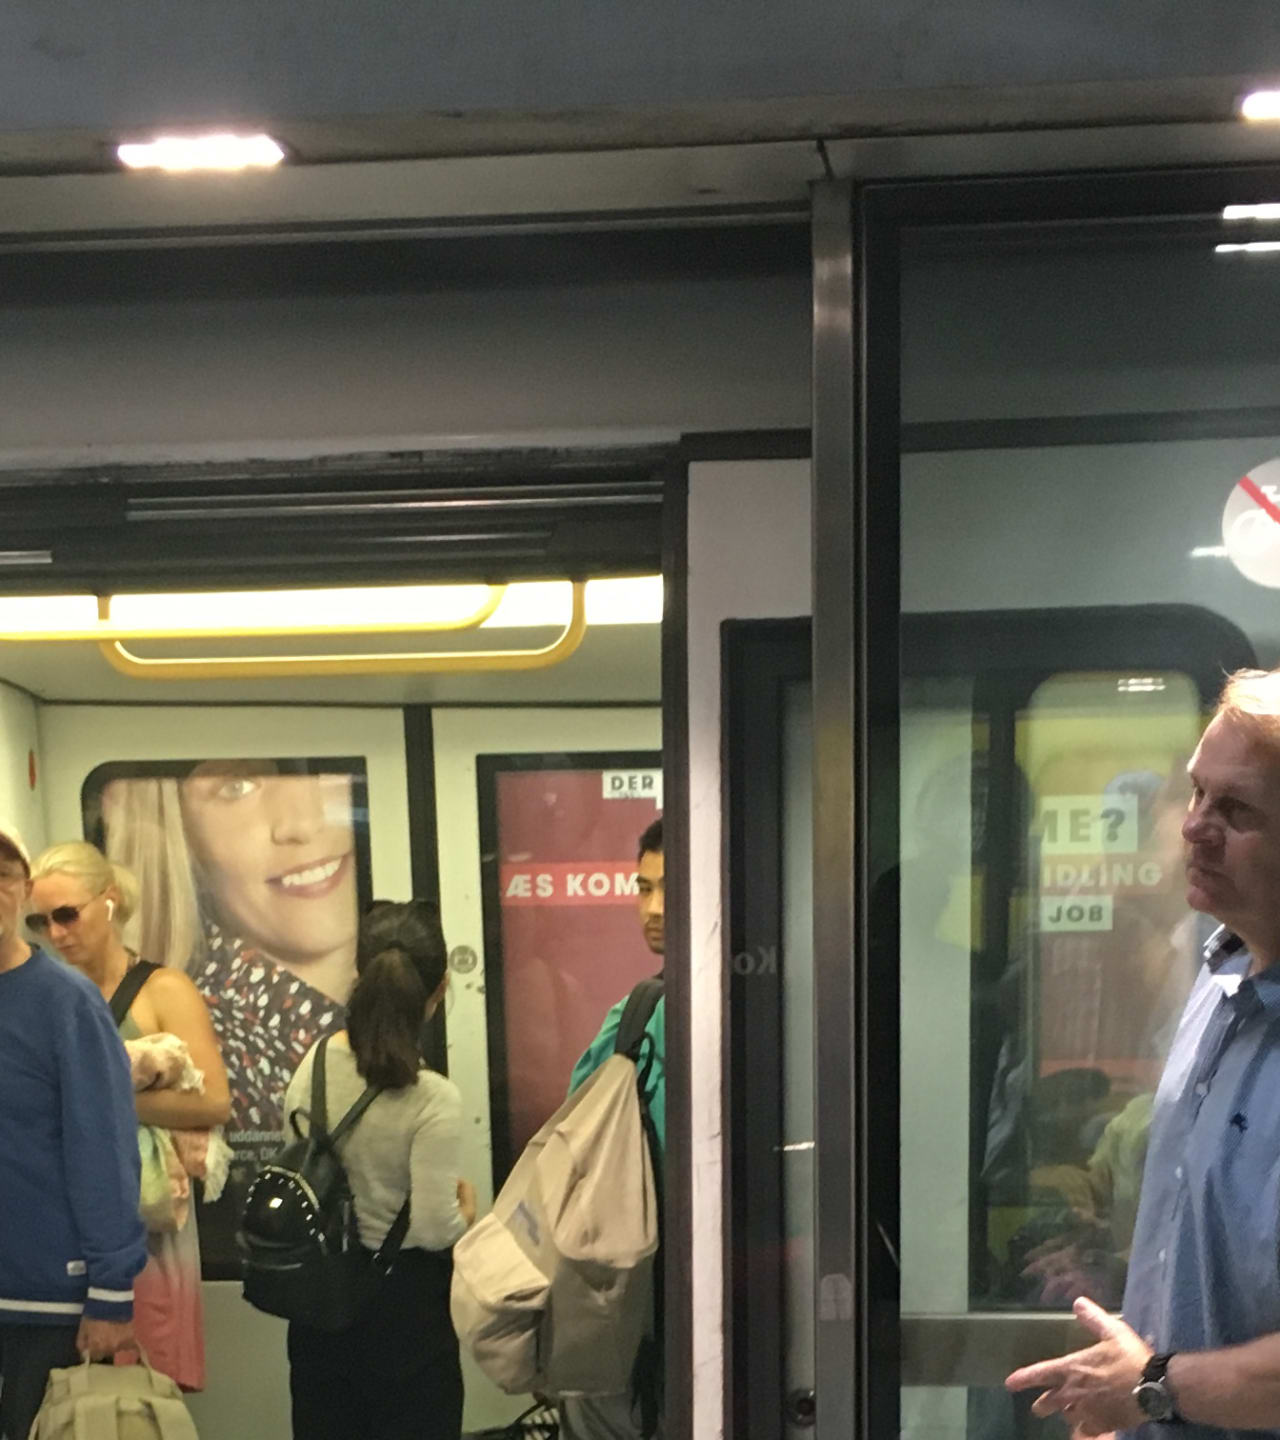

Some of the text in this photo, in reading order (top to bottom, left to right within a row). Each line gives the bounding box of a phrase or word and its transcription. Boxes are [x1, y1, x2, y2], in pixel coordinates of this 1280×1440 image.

[610, 775, 654, 791] DER
[505, 872, 554, 898] ÆS
[1048, 904, 1104, 924] JOB
